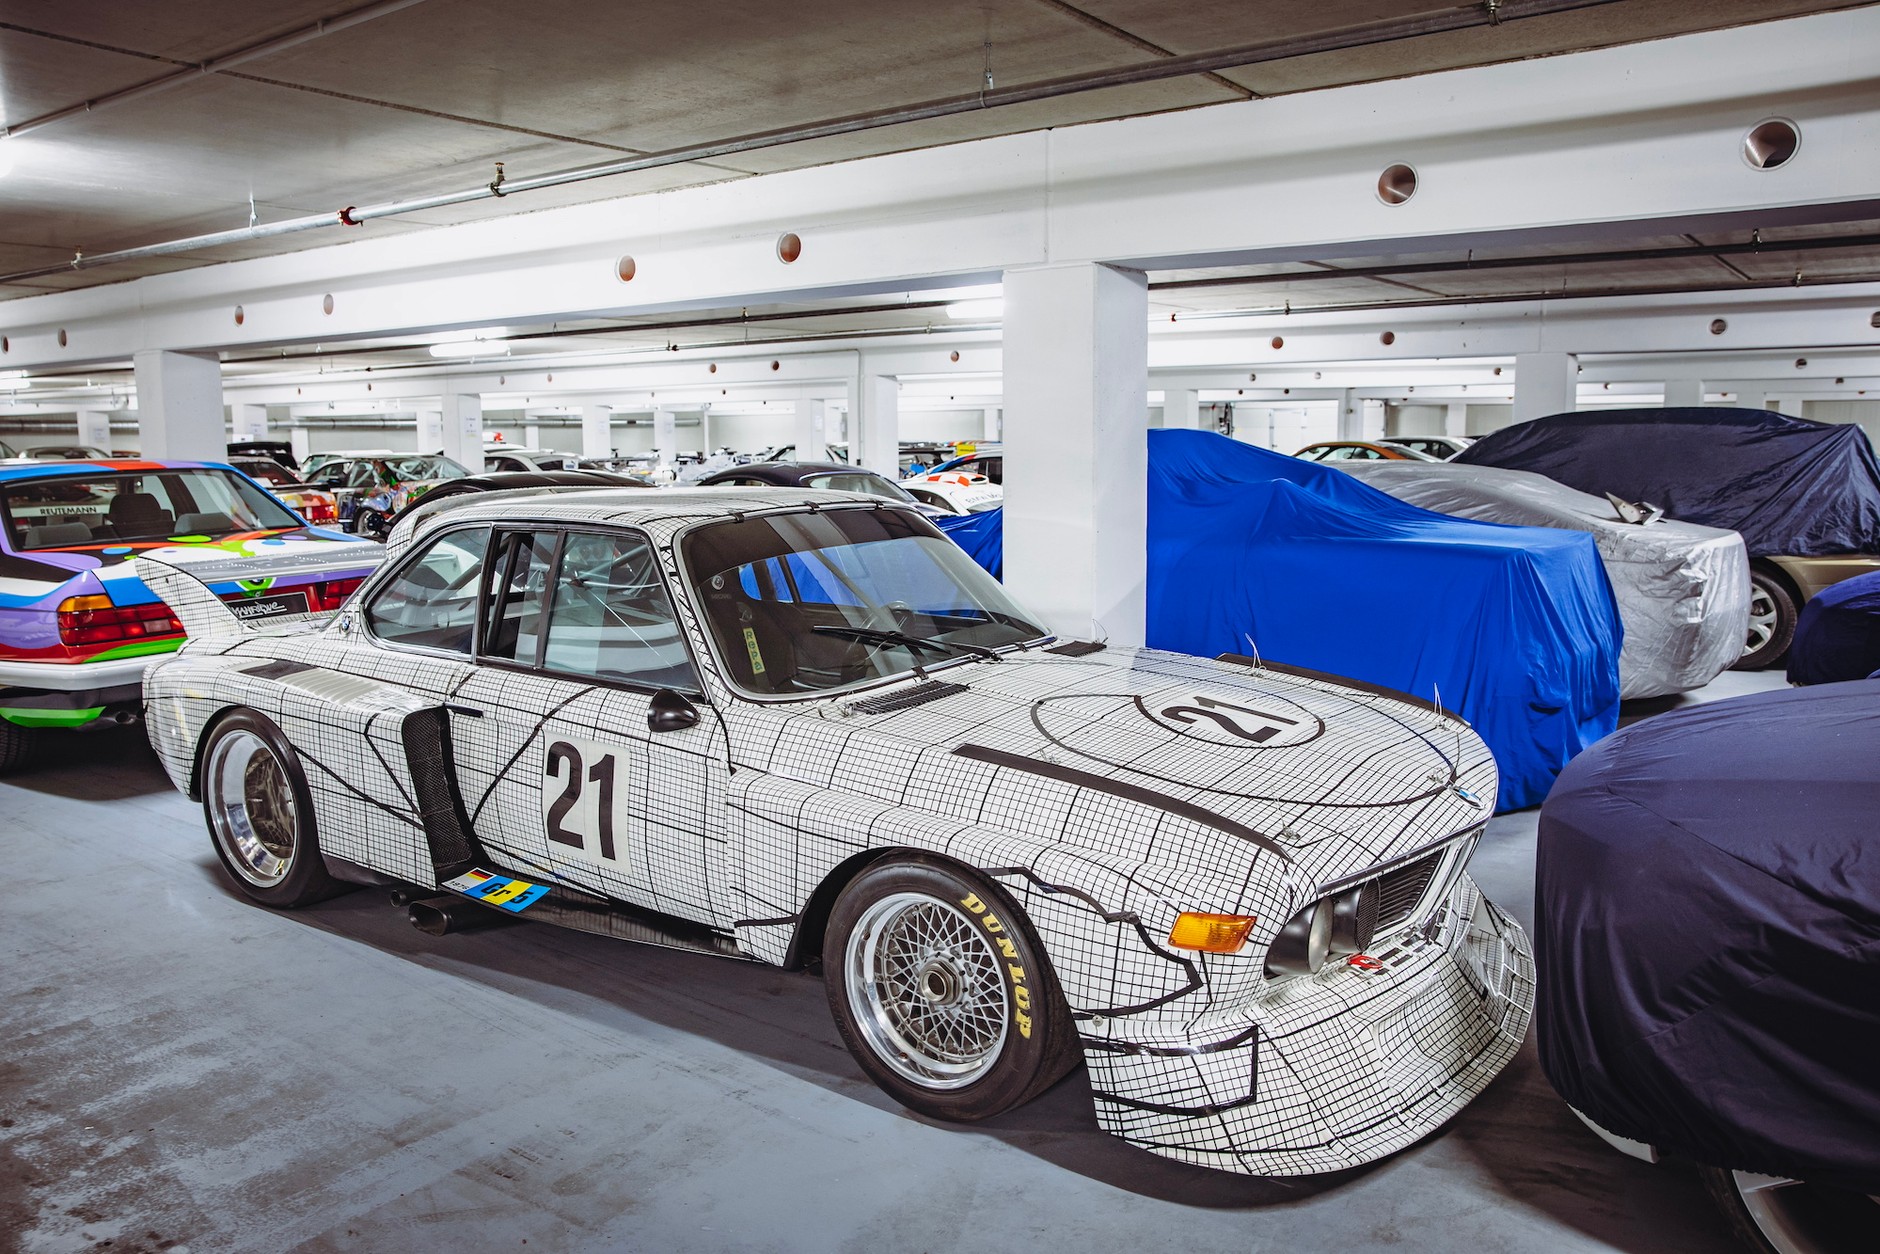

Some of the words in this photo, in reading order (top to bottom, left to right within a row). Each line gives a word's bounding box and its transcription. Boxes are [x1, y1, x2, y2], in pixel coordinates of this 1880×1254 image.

[40, 507, 97, 515] REUTEMANN
[746, 631, 763, 670] Repa
[1161, 696, 1299, 743] 21
[546, 741, 616, 861] 21
[449, 880, 470, 890] 1976
[509, 891, 535, 904] 5
[960, 892, 1032, 1039] DUNLOP
